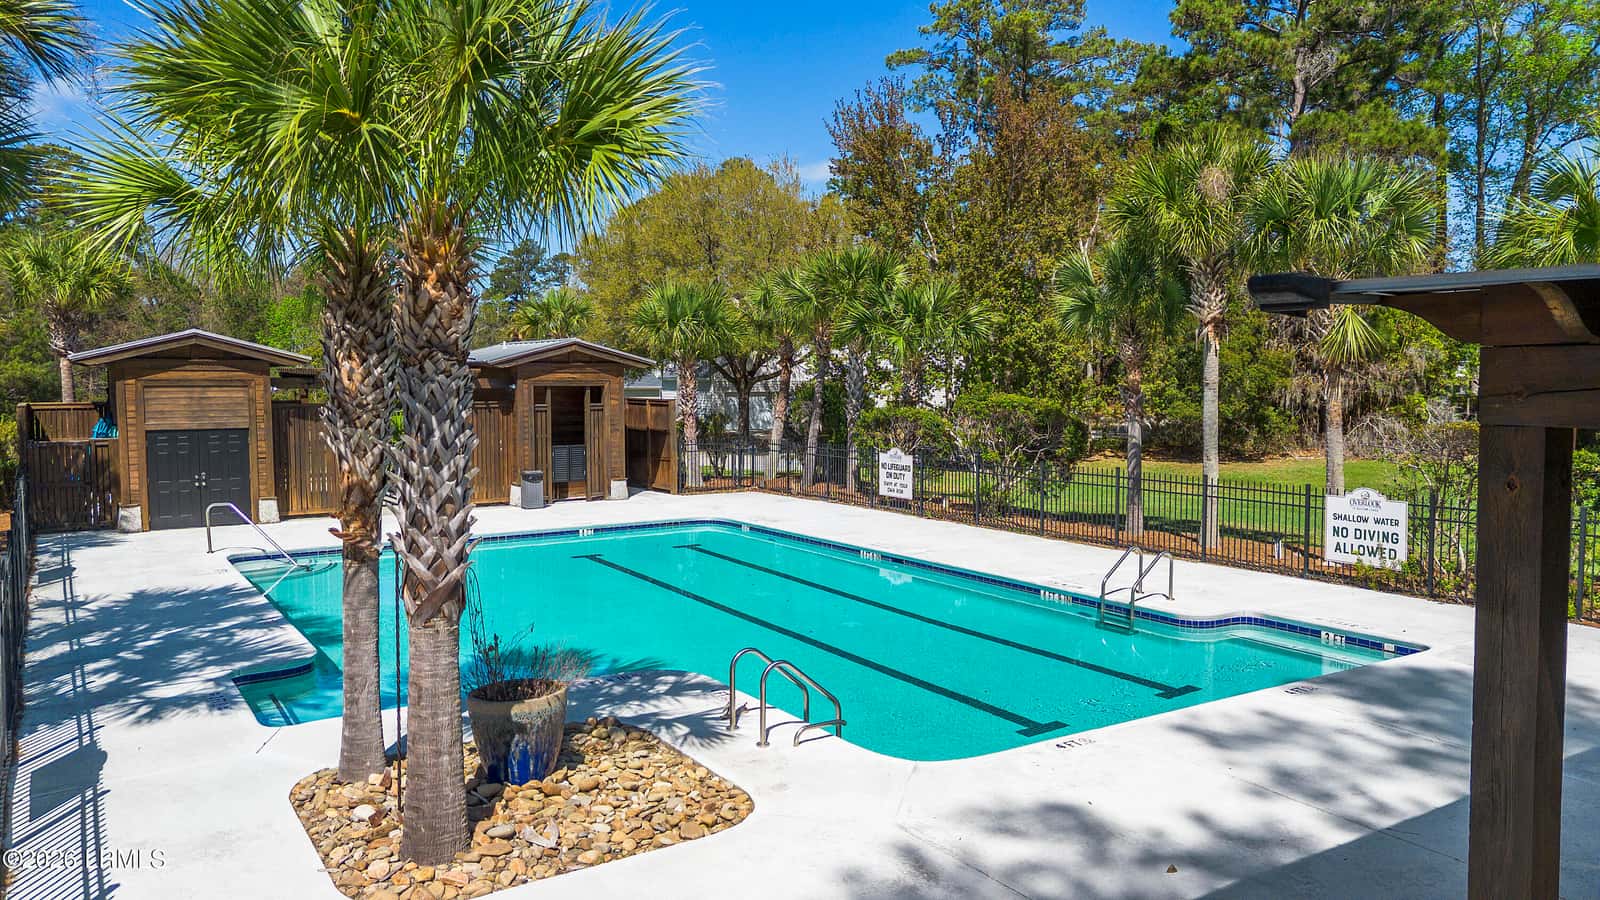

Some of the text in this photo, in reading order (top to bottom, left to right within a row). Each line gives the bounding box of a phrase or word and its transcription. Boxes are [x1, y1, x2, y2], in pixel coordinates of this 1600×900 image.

[881, 462, 911, 472] NO LIFEGUARD
[886, 471, 905, 480] ON DUTY
[1349, 498, 1382, 509] OVERLOOK
[1332, 512, 1400, 527] SHALLOW WATER
[1332, 526, 1400, 544] NO DIVING
[1334, 542, 1397, 560] ALLOWED
[1324, 632, 1344, 643] 3 FT
